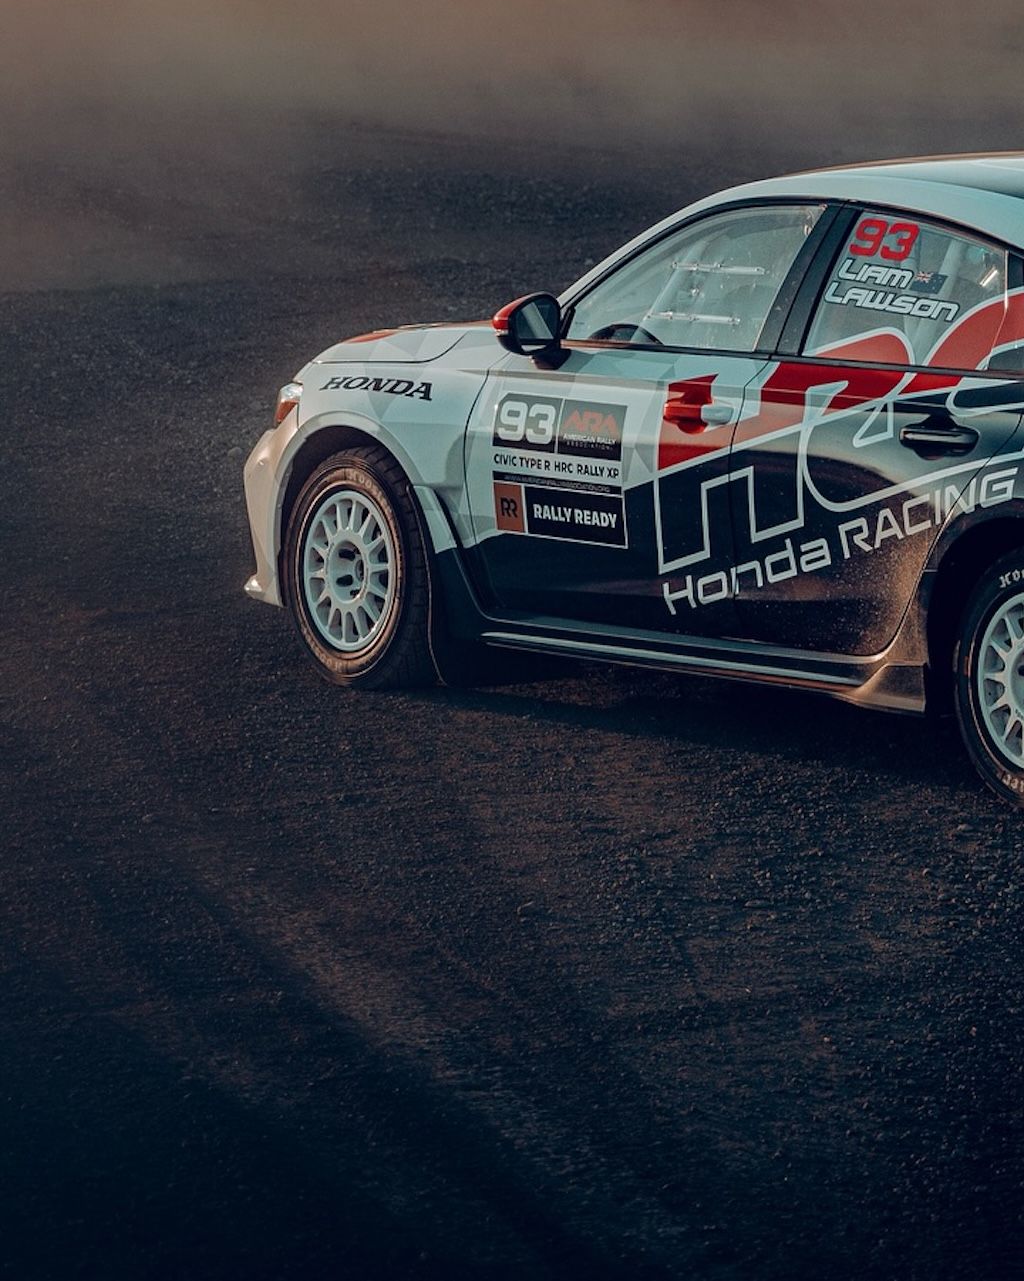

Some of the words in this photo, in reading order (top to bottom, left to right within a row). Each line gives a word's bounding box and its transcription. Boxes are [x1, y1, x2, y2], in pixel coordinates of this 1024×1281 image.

[849, 218, 920, 262] 93
[838, 257, 914, 290] LIAM
[824, 280, 960, 322] LAWSON
[319, 377, 433, 401] HONDA
[497, 401, 556, 444] 93
[562, 409, 620, 435] ARA
[494, 454, 517, 466] CIVIC
[519, 457, 542, 469] TYPE
[544, 460, 551, 471] R
[554, 461, 573, 473] HRC
[577, 464, 604, 477] RALLY
[607, 468, 619, 478] XP
[533, 504, 572, 523] RALLY
[574, 508, 617, 529] READY
[663, 537, 832, 616] Honda
[838, 467, 1018, 559] RACING
